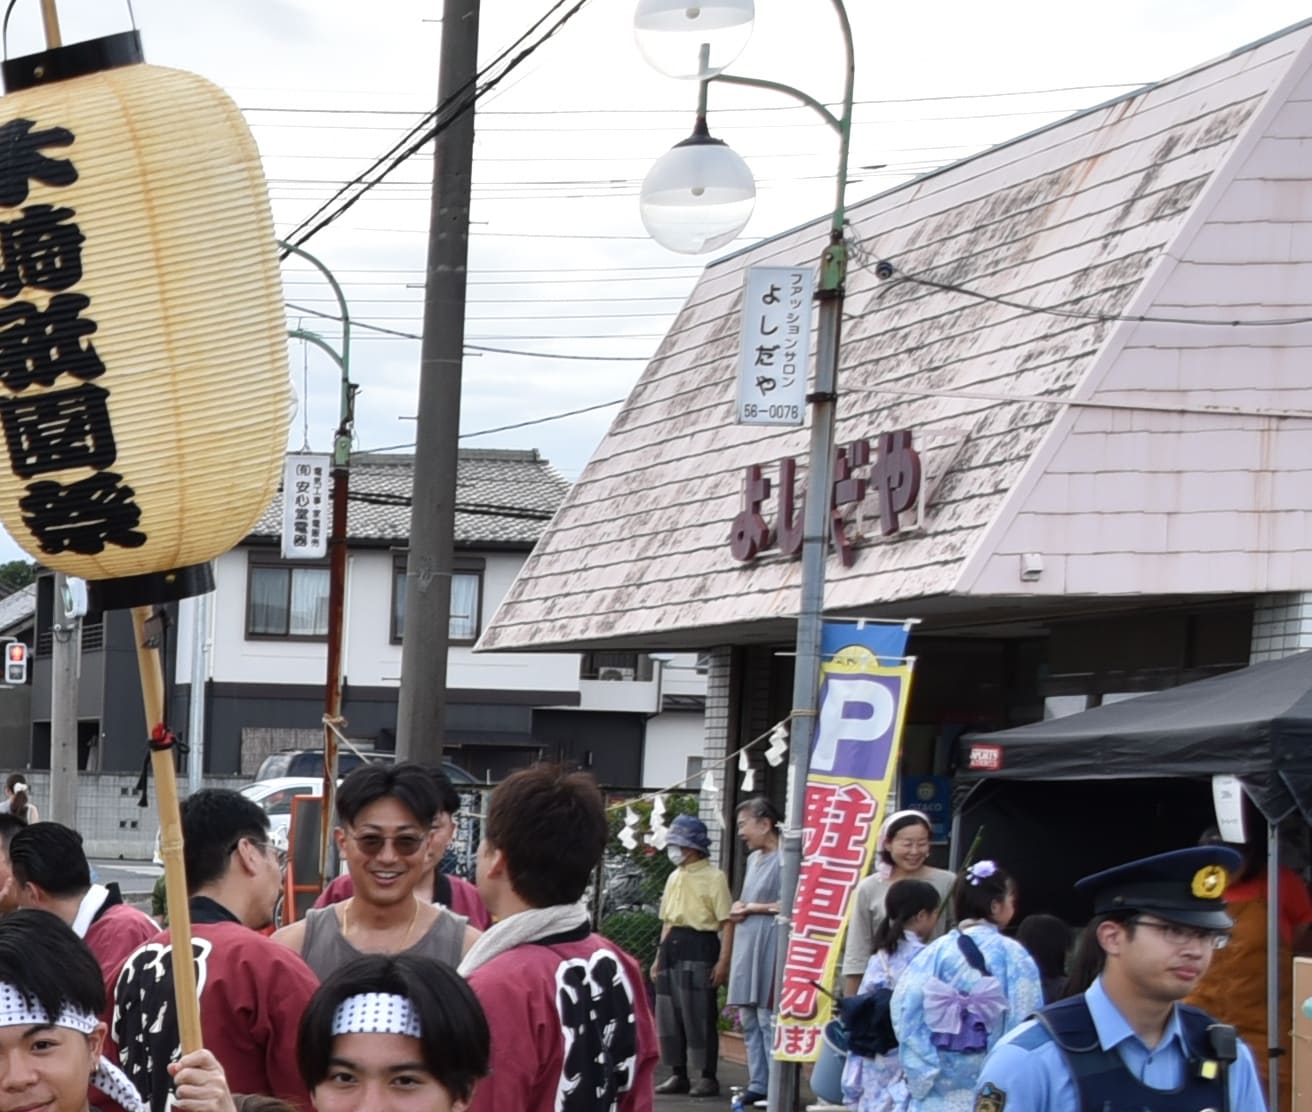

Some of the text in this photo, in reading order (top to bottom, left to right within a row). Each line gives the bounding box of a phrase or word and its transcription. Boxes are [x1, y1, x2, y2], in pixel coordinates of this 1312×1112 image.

[754, 284, 781, 397] よしだや
[782, 273, 804, 388] ファッションサロン
[811, 679, 895, 773] P
